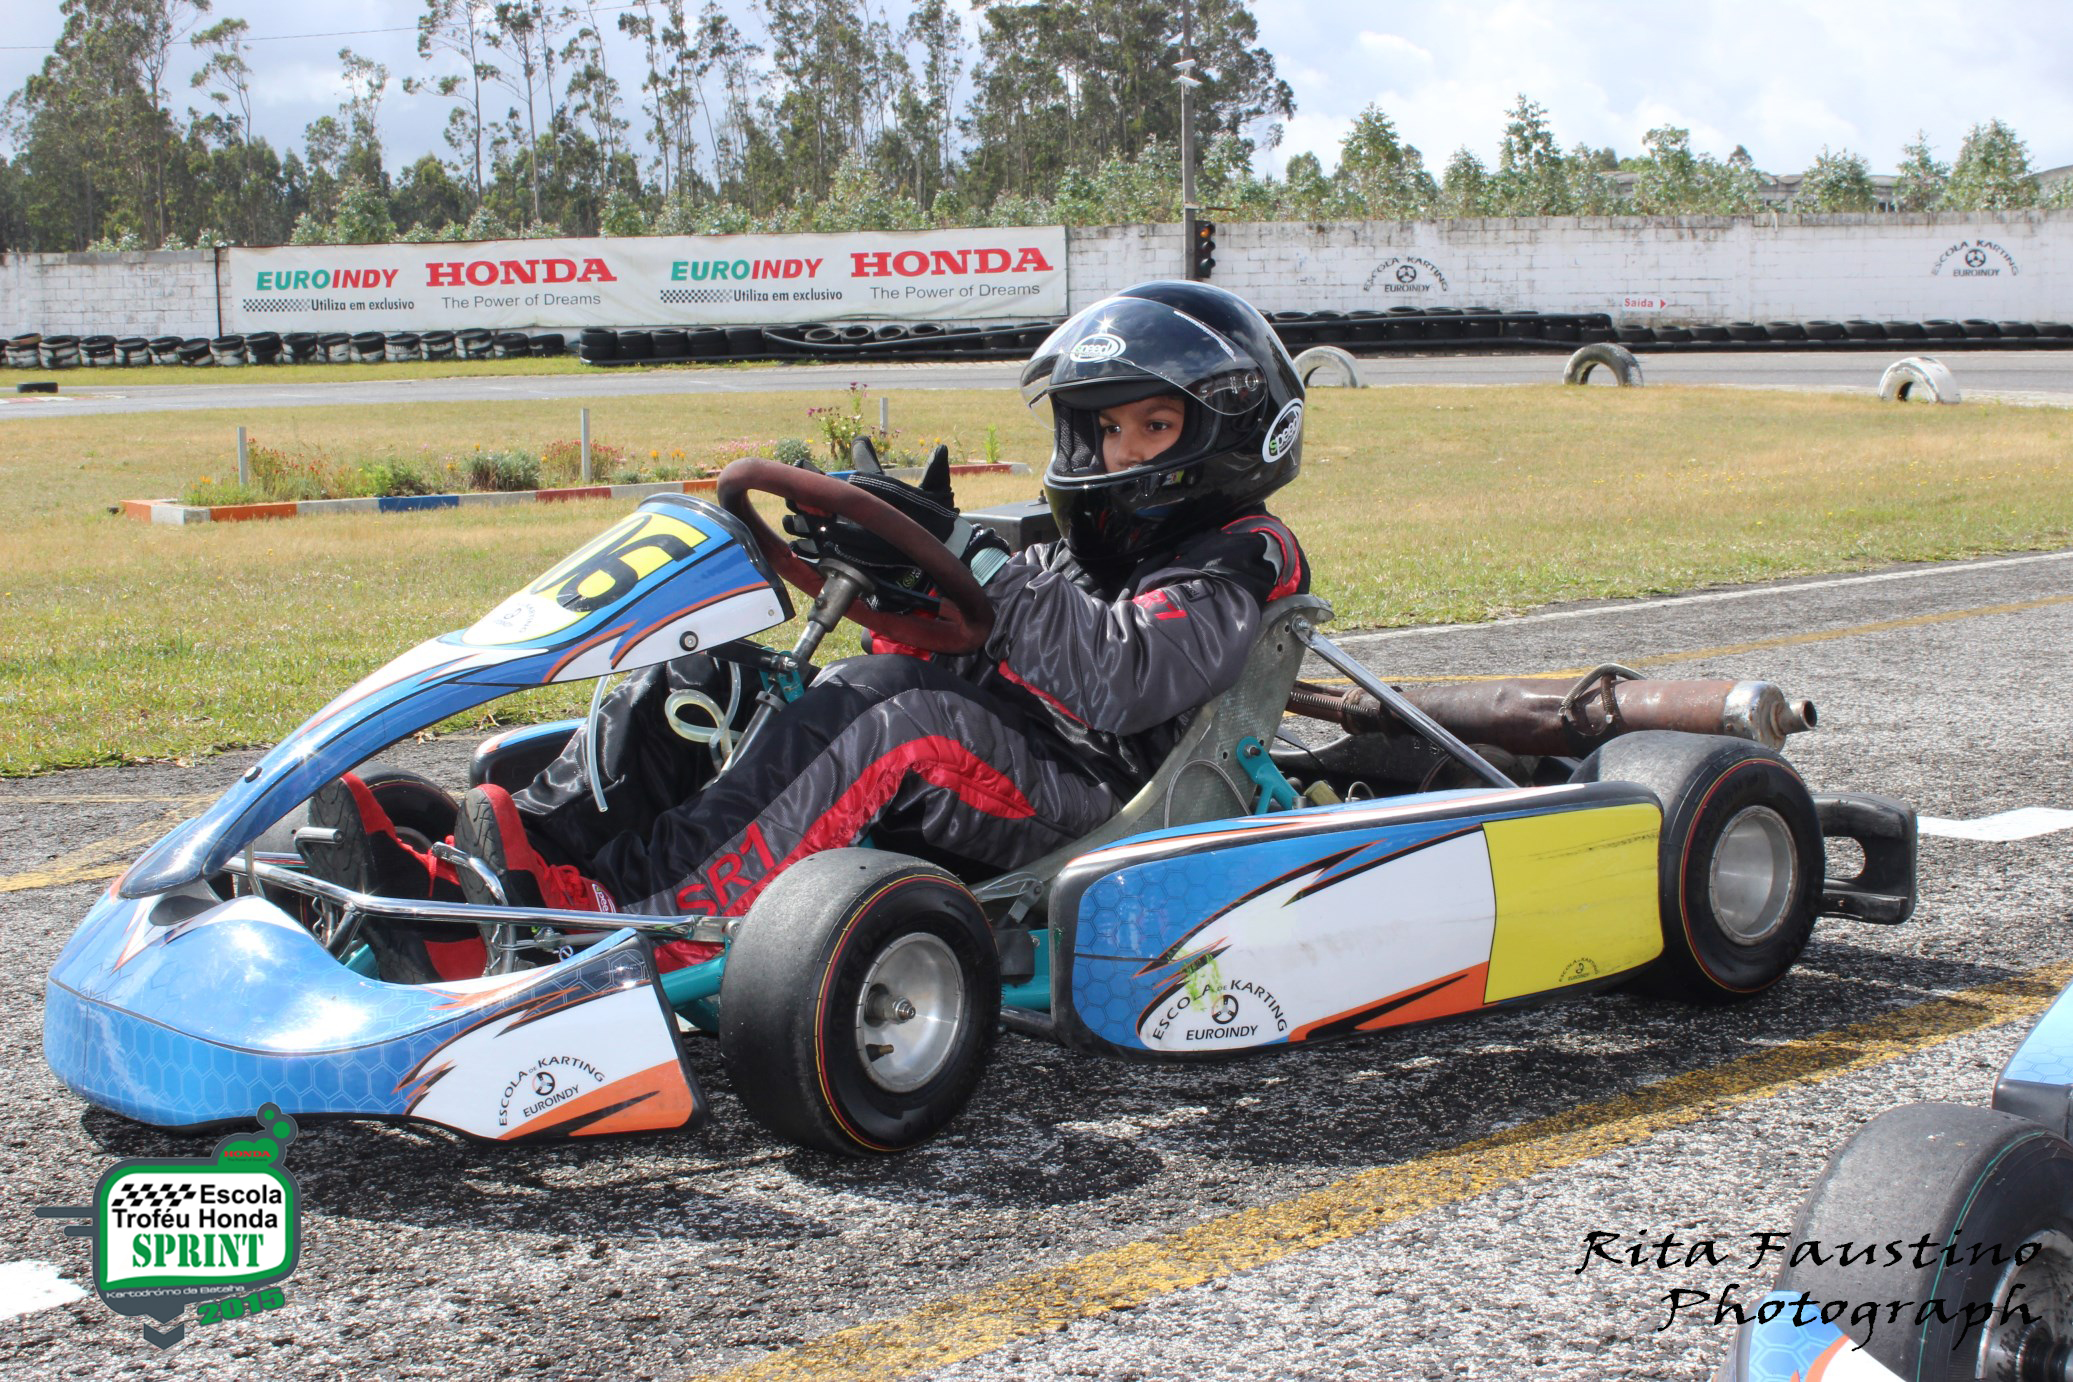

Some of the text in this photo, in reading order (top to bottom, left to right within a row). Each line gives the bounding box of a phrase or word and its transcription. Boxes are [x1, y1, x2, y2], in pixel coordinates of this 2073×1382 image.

[850, 247, 1054, 278] HONDA
[1976, 239, 2019, 276] KARTING
[256, 268, 400, 291] EUROINDY
[425, 258, 618, 287] HONDA
[671, 258, 824, 281] EUROINDY
[1407, 256, 1449, 292] KARTING
[1953, 268, 2000, 277] EUROINDY
[733, 289, 843, 302] Utiliza em exclusivo
[869, 282, 1041, 299] The Power of Dreams
[1384, 284, 1431, 293] EUROINDY
[311, 299, 415, 312] Utiliza em exclusivo
[442, 293, 601, 309] The Power of Dreams
[1152, 983, 1216, 1041] ESCOLA
[1230, 979, 1288, 1032] KARTING
[1186, 1025, 1259, 1041] EUROINDY
[499, 1070, 528, 1126] ESCOLA
[538, 1056, 605, 1083] KARTING
[523, 1084, 579, 1118] EUROINDY
